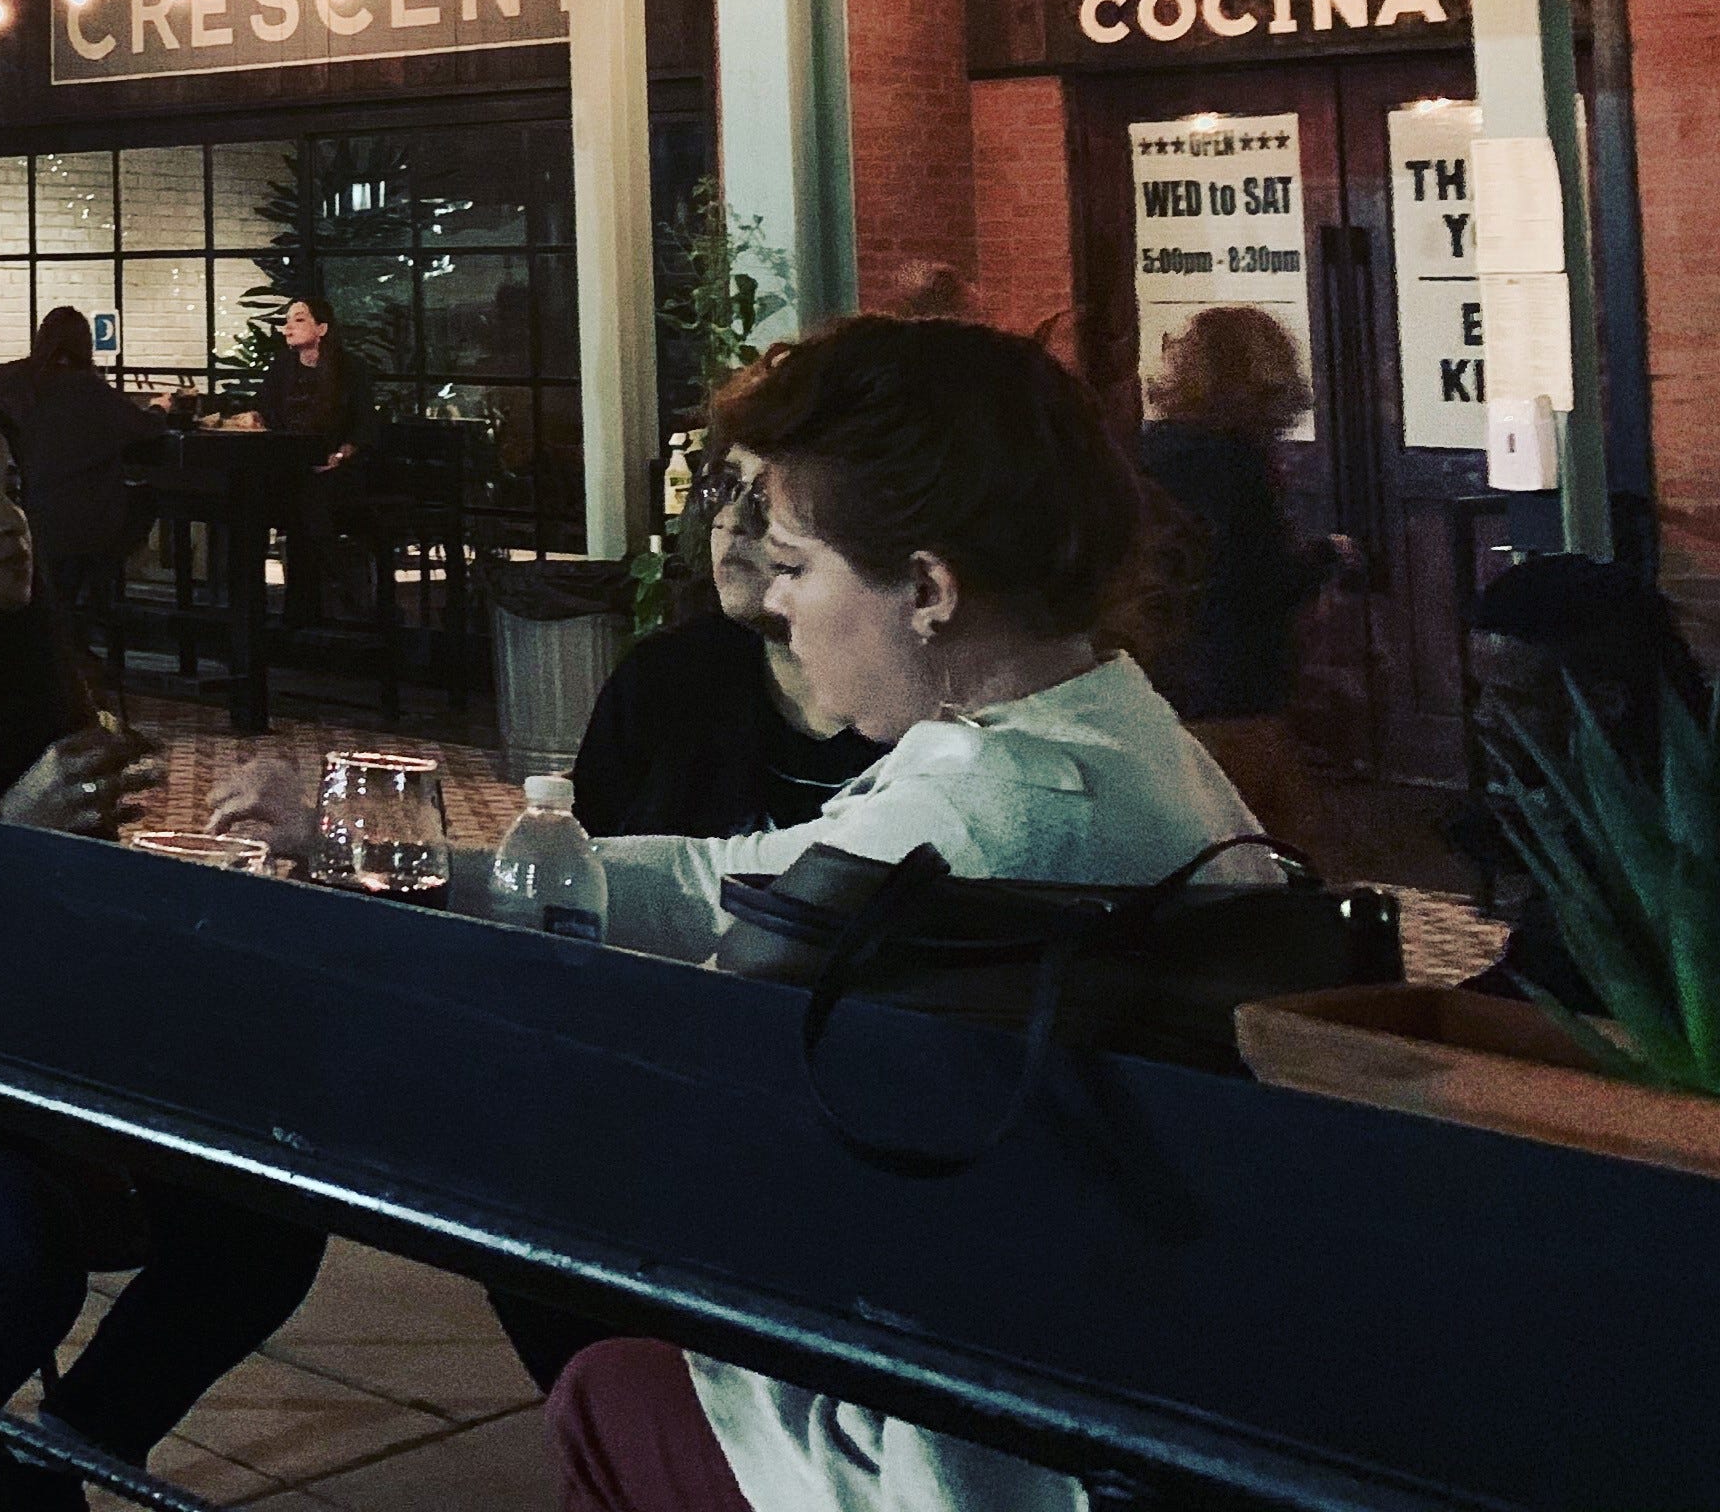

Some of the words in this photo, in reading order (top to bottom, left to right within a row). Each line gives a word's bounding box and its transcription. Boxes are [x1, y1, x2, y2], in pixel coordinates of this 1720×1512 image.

[1141, 179, 1202, 218] WED
[1208, 181, 1236, 216] to
[1243, 176, 1292, 216] SAT
[1405, 158, 1467, 202] TH
